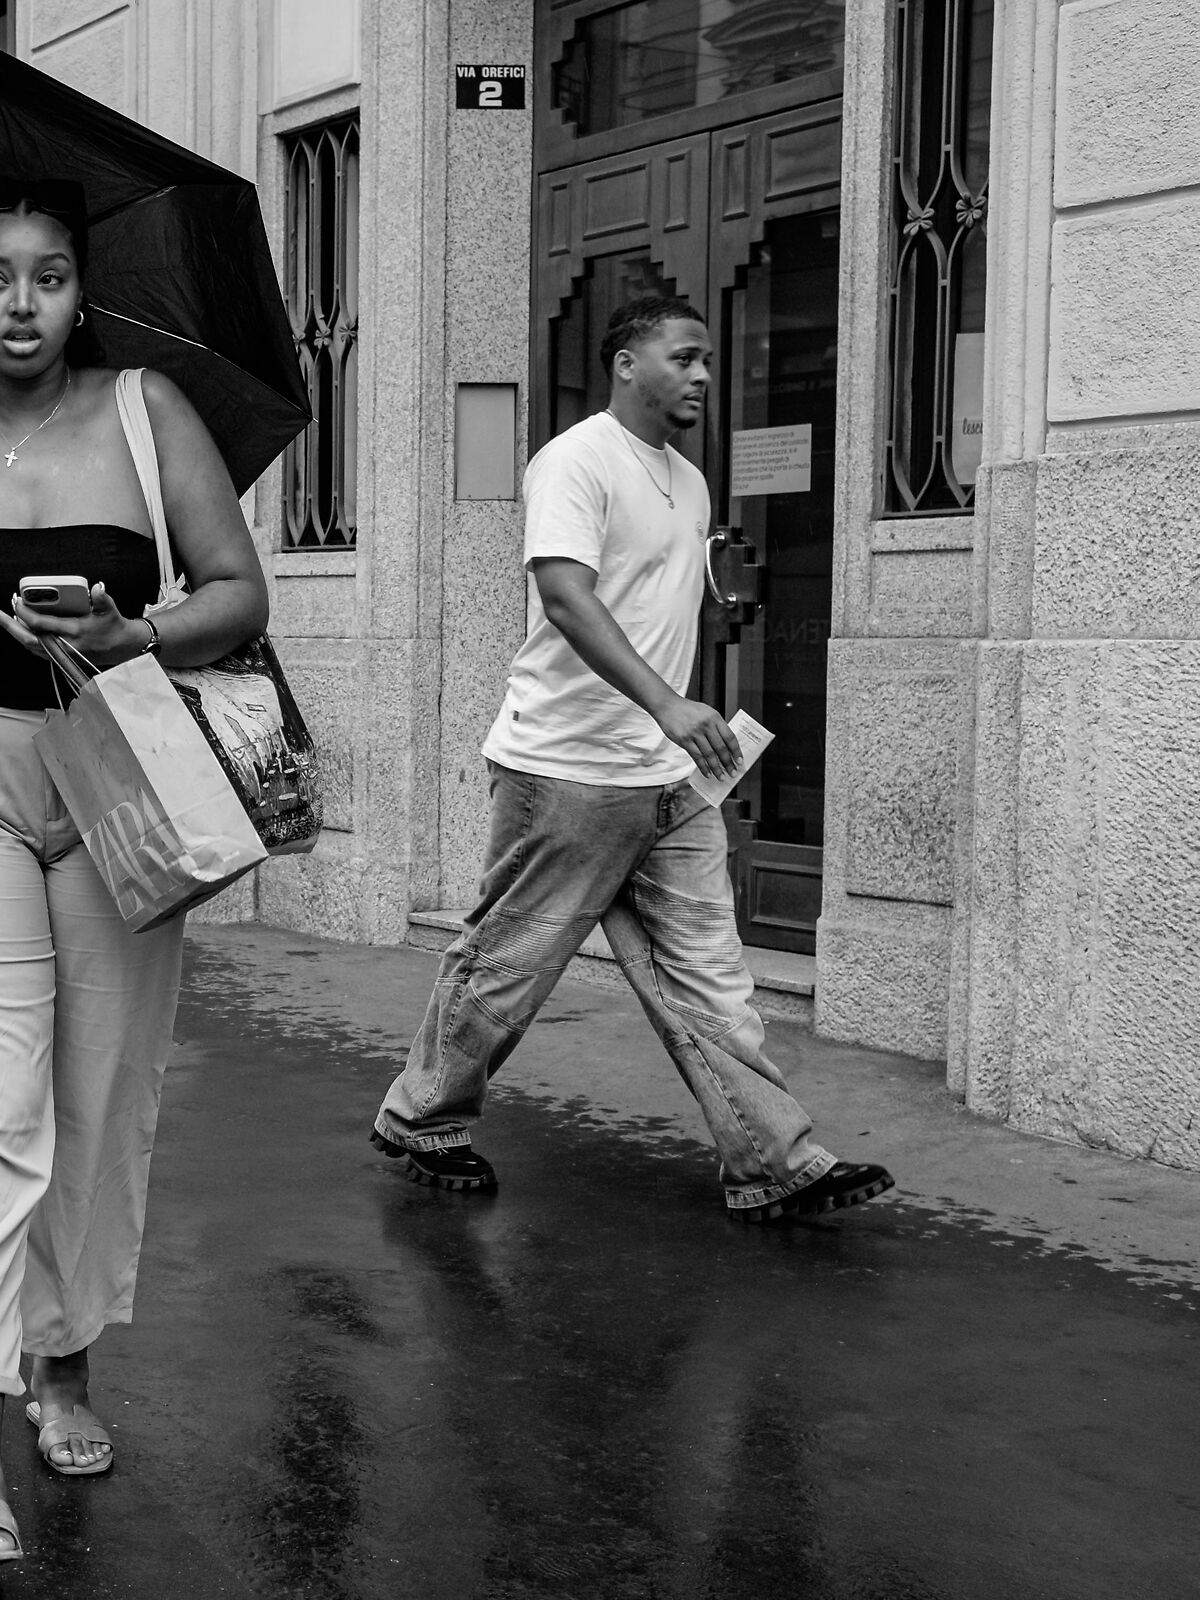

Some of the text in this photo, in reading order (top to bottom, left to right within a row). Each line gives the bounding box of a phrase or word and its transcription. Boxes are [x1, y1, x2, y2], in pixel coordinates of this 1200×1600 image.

[457, 66, 524, 78] VIA OREFICI
[479, 80, 502, 107] 2
[82, 786, 198, 921] ZARA
